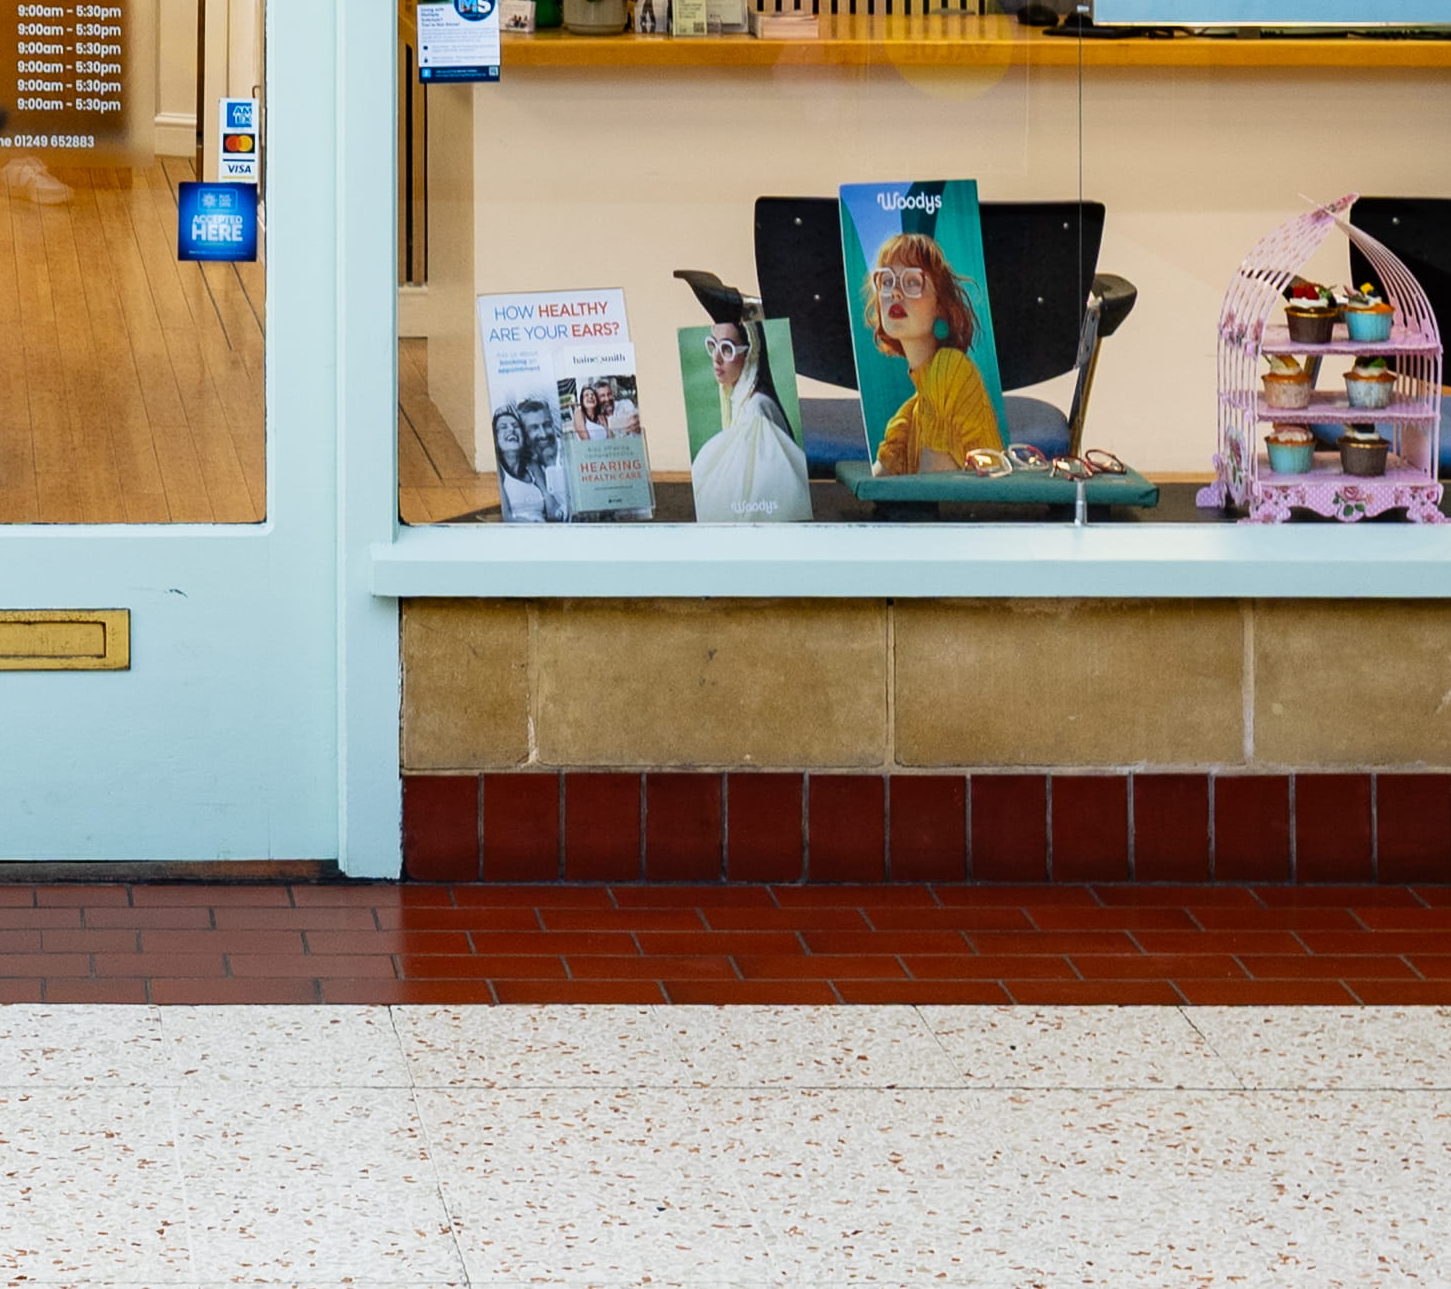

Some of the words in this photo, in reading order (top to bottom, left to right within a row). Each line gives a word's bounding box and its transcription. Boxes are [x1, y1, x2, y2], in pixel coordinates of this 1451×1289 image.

[17, 4, 64, 17] 9:00am
[76, 4, 122, 21] 5:30pm
[17, 23, 64, 36] 9:00am
[76, 23, 122, 40] 5:30pm
[17, 41, 64, 54] 9:00am
[76, 41, 122, 58] 5:30pm
[17, 60, 64, 73] 9:00am
[76, 60, 122, 77] 5:30pm
[17, 79, 64, 92] 9:00am
[76, 79, 122, 96] 5:30pm
[17, 97, 64, 110] 9:00am
[76, 97, 122, 114] 5:30pm
[14, 135, 48, 148] 01249
[50, 135, 95, 148] 652883
[227, 165, 252, 173] VISA
[876, 191, 944, 216] Woodys
[192, 214, 243, 224] ACCEPTED
[191, 223, 244, 242] HERE
[494, 305, 535, 321] HOW
[538, 301, 609, 318] HEALTHY
[489, 326, 522, 343] ARE
[524, 324, 569, 341] YOUR
[571, 321, 620, 338] EARS?
[579, 460, 642, 473] HEARING
[581, 474, 616, 483] HEALTH
[619, 472, 643, 481] CARE
[729, 497, 779, 516] Woodys
